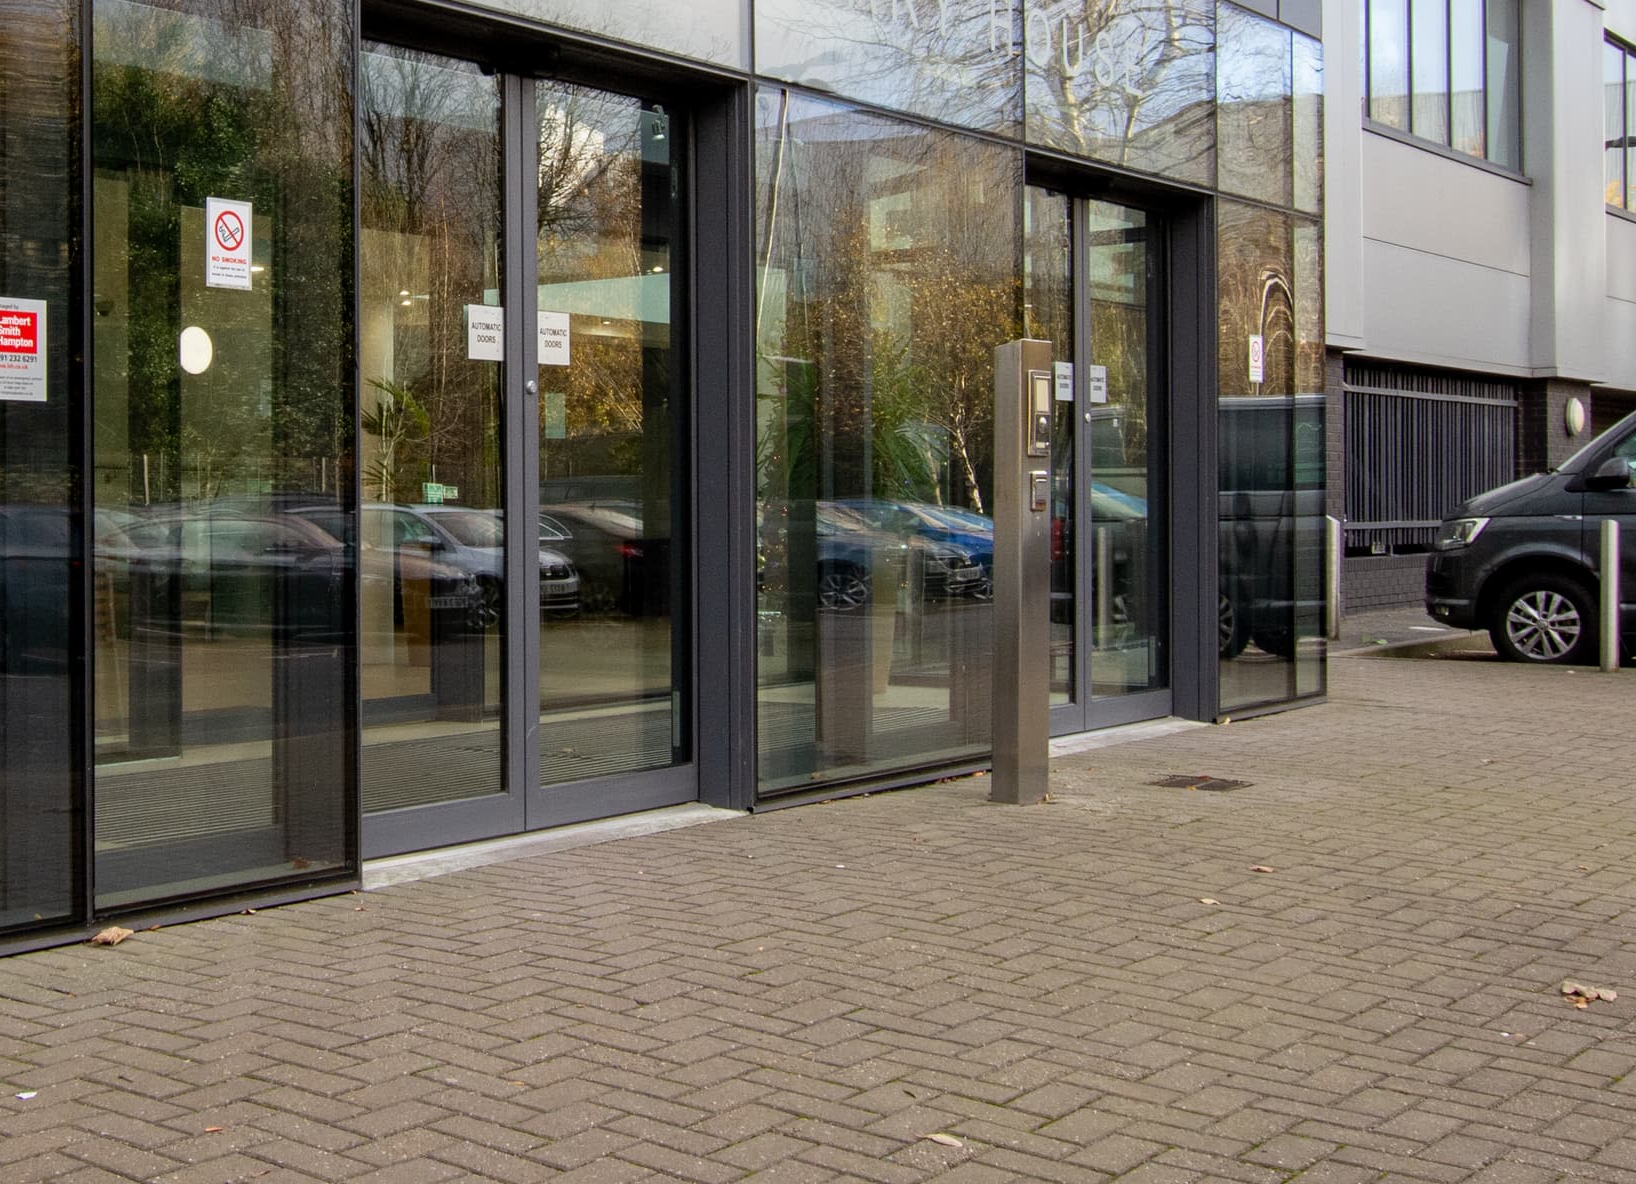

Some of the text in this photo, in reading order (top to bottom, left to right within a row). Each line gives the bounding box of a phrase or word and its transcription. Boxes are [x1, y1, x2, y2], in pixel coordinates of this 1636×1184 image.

[222, 257, 247, 265] SMOKING
[471, 322, 502, 332] AUTOMATIC
[539, 327, 567, 337] AUTOMATIC
[477, 334, 496, 344] DOORS
[544, 340, 562, 348] DOORS
[22, 355, 37, 363] 6291
